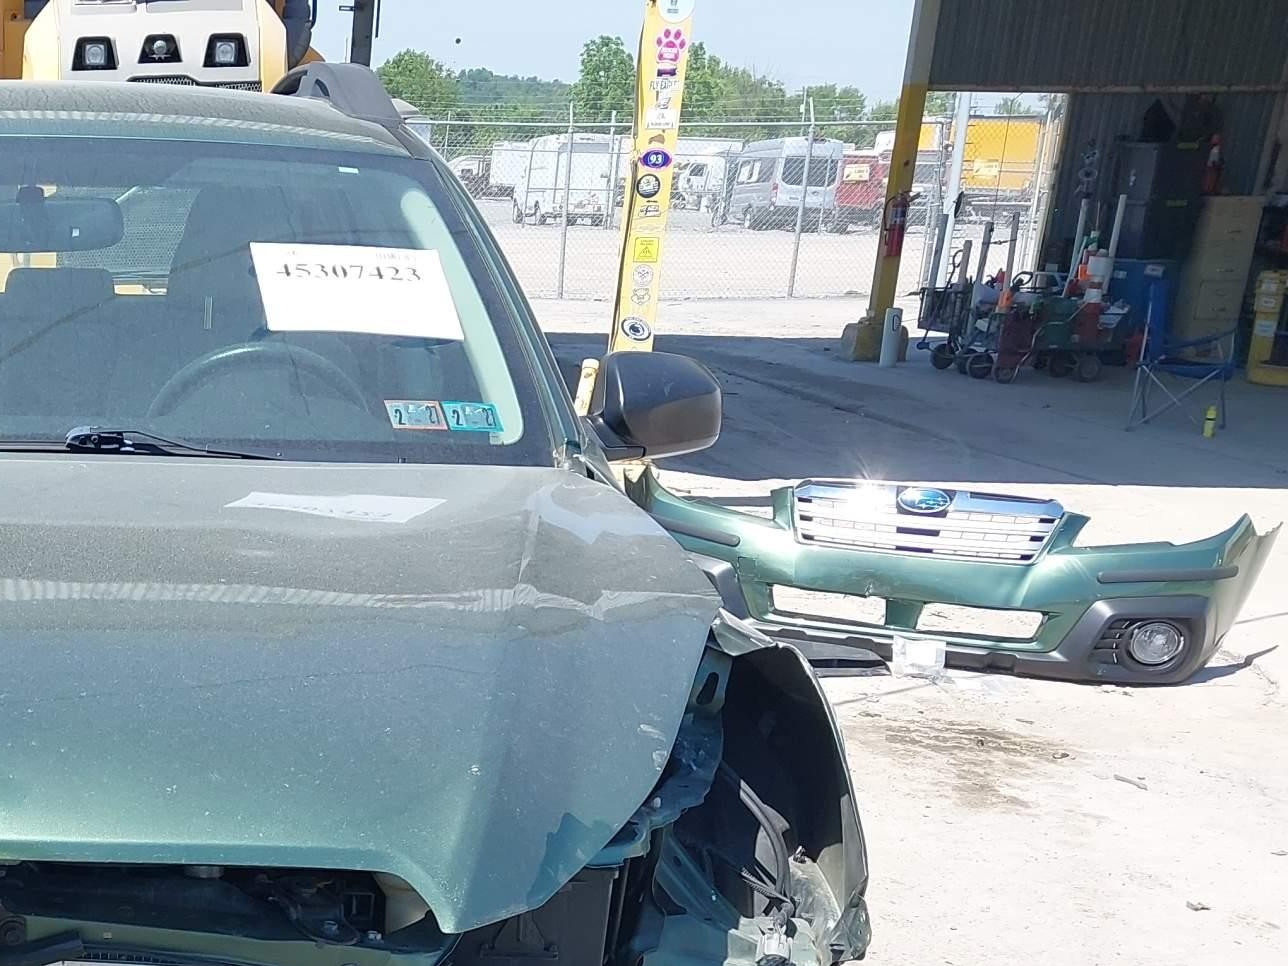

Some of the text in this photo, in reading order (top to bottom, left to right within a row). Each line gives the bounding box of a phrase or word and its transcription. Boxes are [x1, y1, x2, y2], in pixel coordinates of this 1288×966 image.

[650, 155, 663, 164] 93
[276, 263, 422, 282] 45307423
[394, 408, 407, 426] 2
[452, 409, 464, 426] 2
